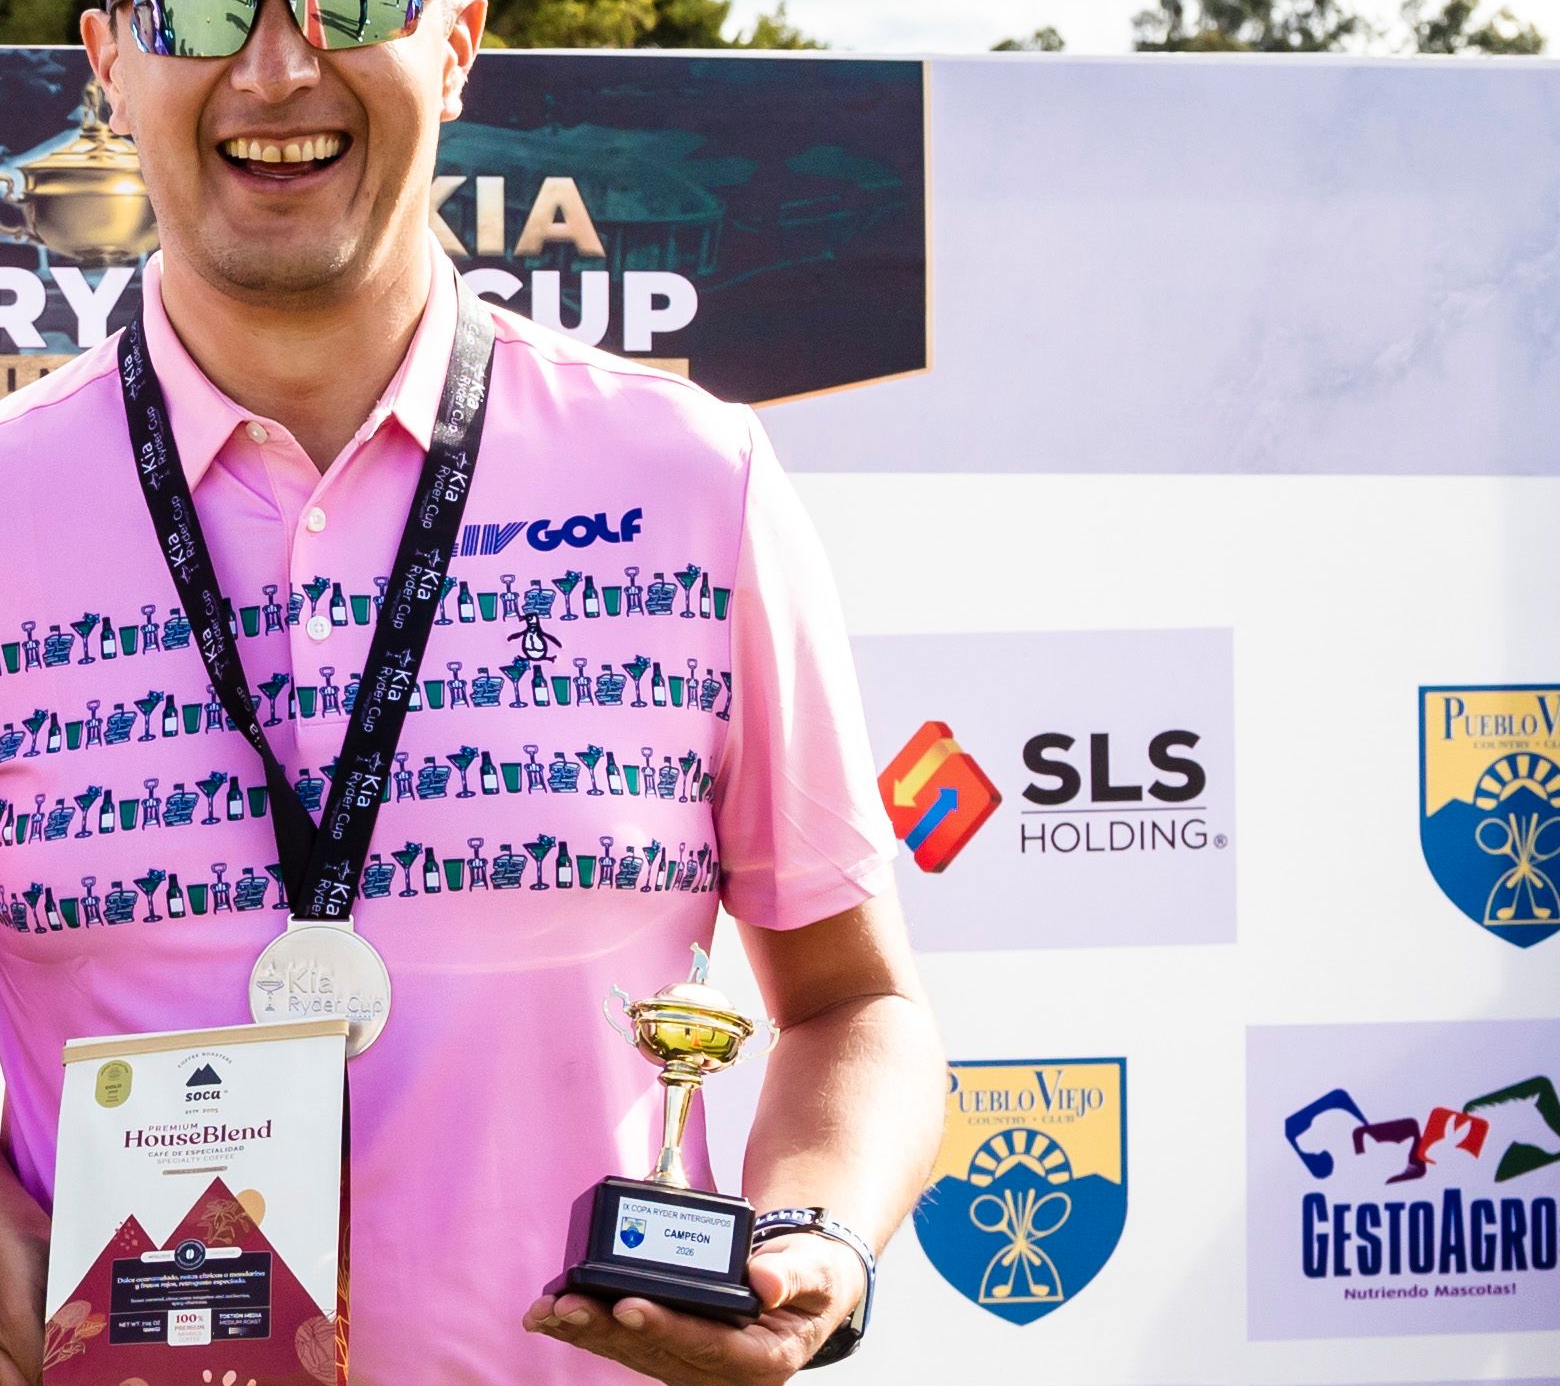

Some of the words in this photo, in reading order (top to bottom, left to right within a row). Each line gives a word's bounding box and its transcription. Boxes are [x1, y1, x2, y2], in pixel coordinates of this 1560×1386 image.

[467, 379, 485, 410] Kia
[147, 406, 157, 431] Cup
[448, 409, 464, 434] Cup
[142, 442, 157, 474] Kia
[445, 469, 467, 502] Kia
[171, 495, 183, 521] Cup
[422, 504, 439, 529] Cup
[451, 521, 528, 558] IV
[526, 507, 643, 552] GOLF
[168, 533, 186, 567] Kia
[417, 568, 441, 601] Kia
[394, 604, 411, 629] Cup
[202, 628, 218, 664] Kia
[387, 669, 413, 702] Kia
[363, 706, 381, 733] Cup
[1443, 696, 1536, 741] PUEBLO
[1021, 729, 1206, 805] SLS
[357, 774, 381, 808] Kia
[333, 813, 350, 840] Cup
[1021, 817, 1208, 853] HOLDING
[326, 882, 351, 916] Kia
[288, 965, 334, 994] Kia
[288, 996, 341, 1015] Ryder
[347, 996, 383, 1017] Cup
[185, 1089, 221, 1102] soca
[1036, 1070, 1103, 1117] VIEJO
[124, 1119, 272, 1148] HouseBlend
[148, 1123, 198, 1132] PREMIUM
[172, 1149, 183, 1157] DE
[185, 1145, 245, 1157] ESPECIALIDAD
[622, 1203, 629, 1211] IX
[631, 1204, 651, 1214] COPA
[653, 1208, 678, 1219] RYDER
[679, 1212, 731, 1228] INTERGRUPOS
[664, 1228, 711, 1244] CAMPEÓN
[676, 1246, 694, 1257] 2026
[1344, 1285, 1428, 1300] Nutriendo
[1434, 1283, 1516, 1298] Mascotas!
